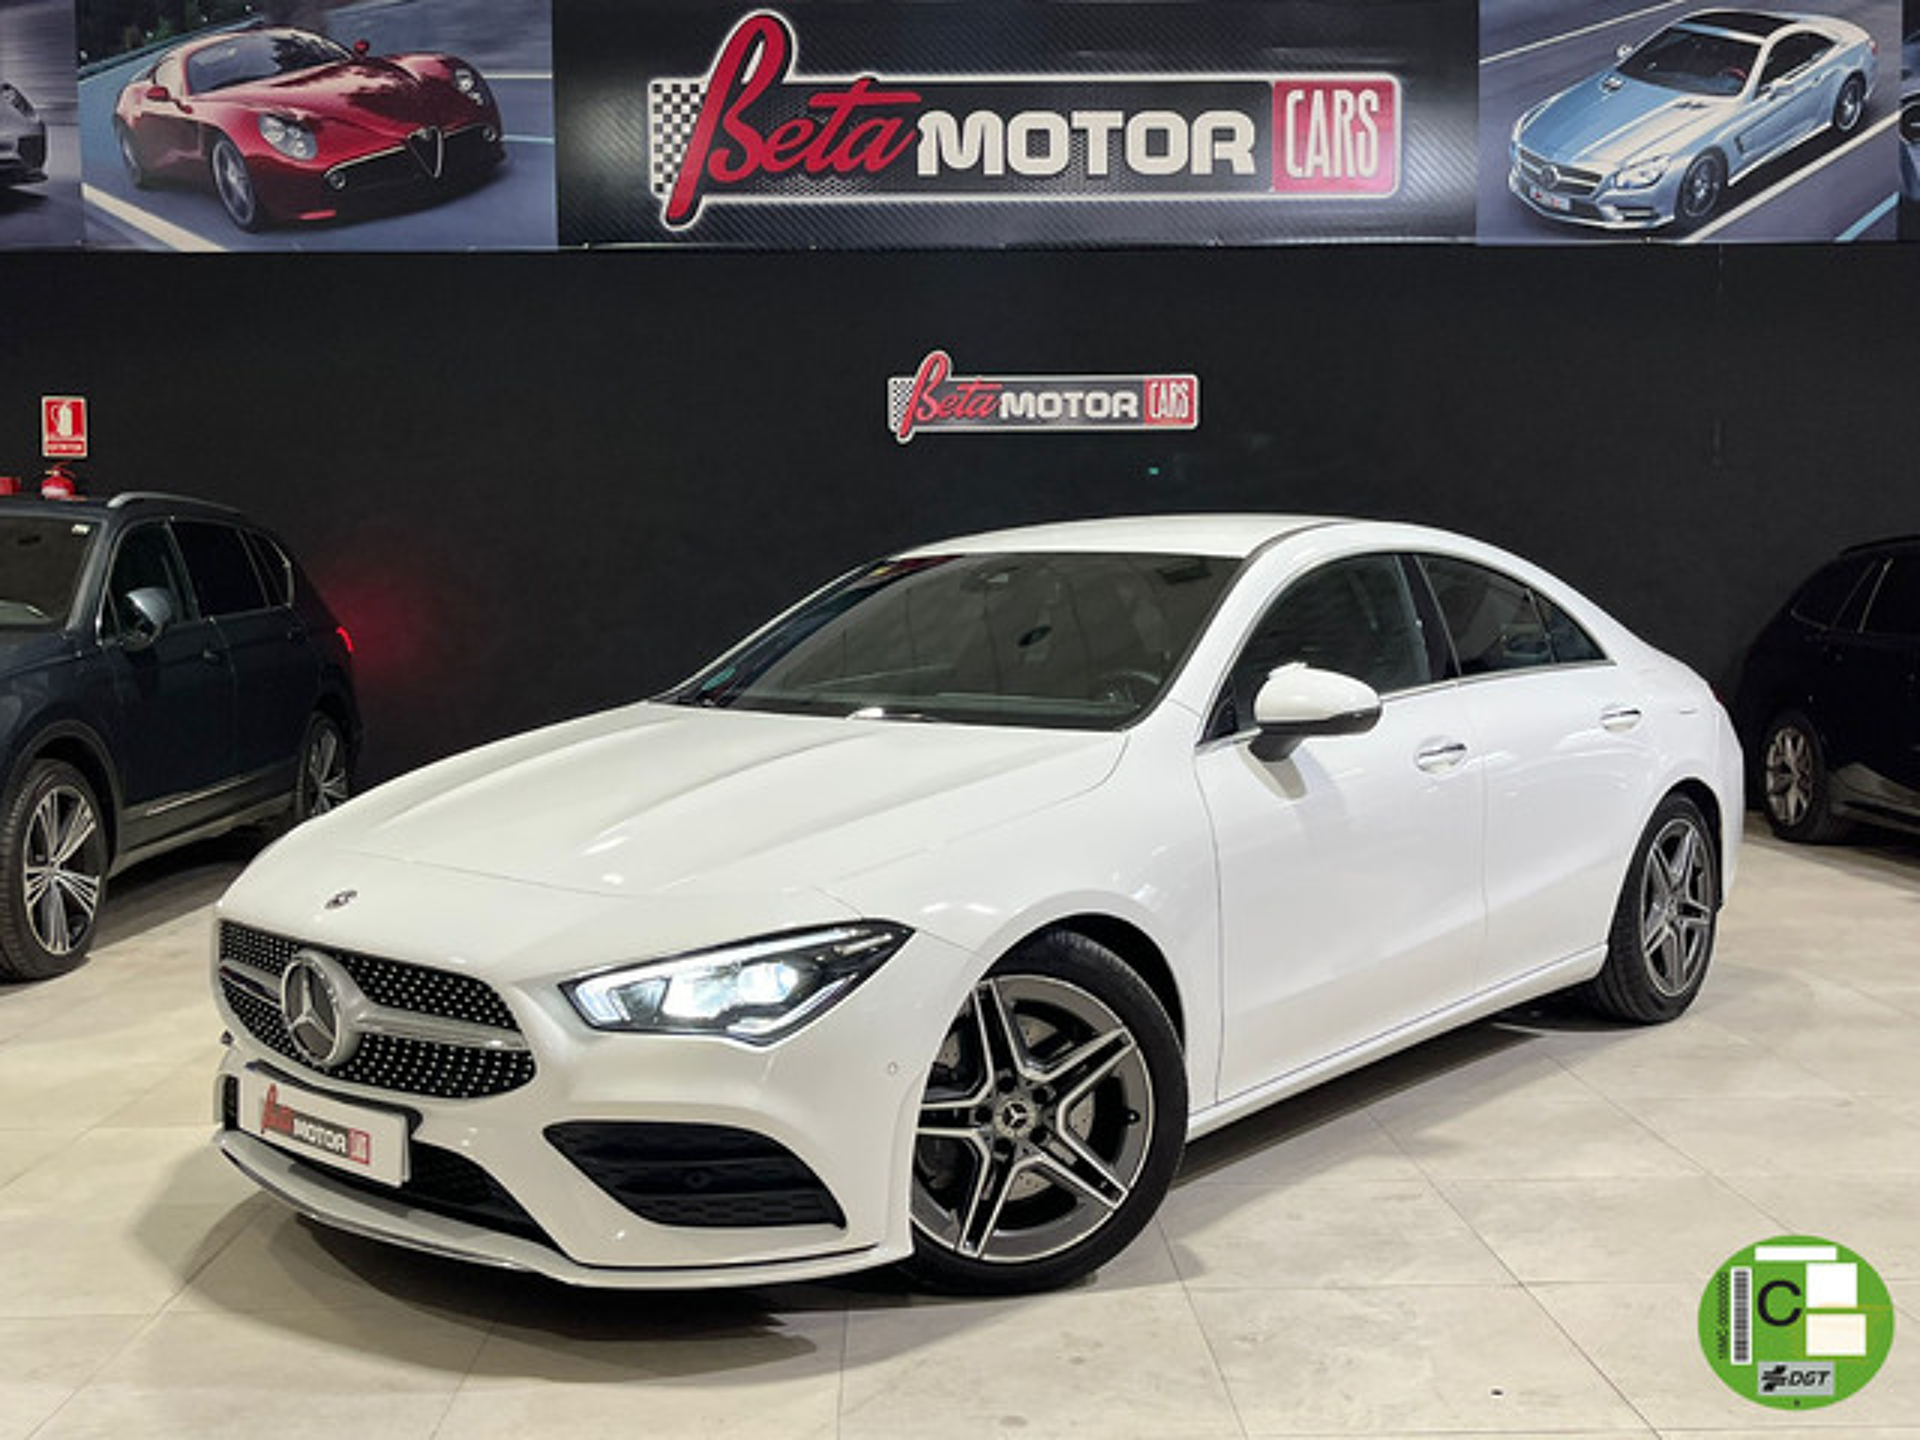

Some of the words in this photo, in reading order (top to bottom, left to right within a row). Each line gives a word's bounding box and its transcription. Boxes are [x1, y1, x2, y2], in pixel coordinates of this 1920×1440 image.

[666, 14, 921, 219] Beta
[917, 110, 1256, 177] MOTOR
[1284, 88, 1380, 180] CARS
[899, 354, 1002, 437] Beta
[999, 391, 1138, 419] MOTOR
[1150, 380, 1190, 419] CARS
[293, 1118, 347, 1154] MOTOR
